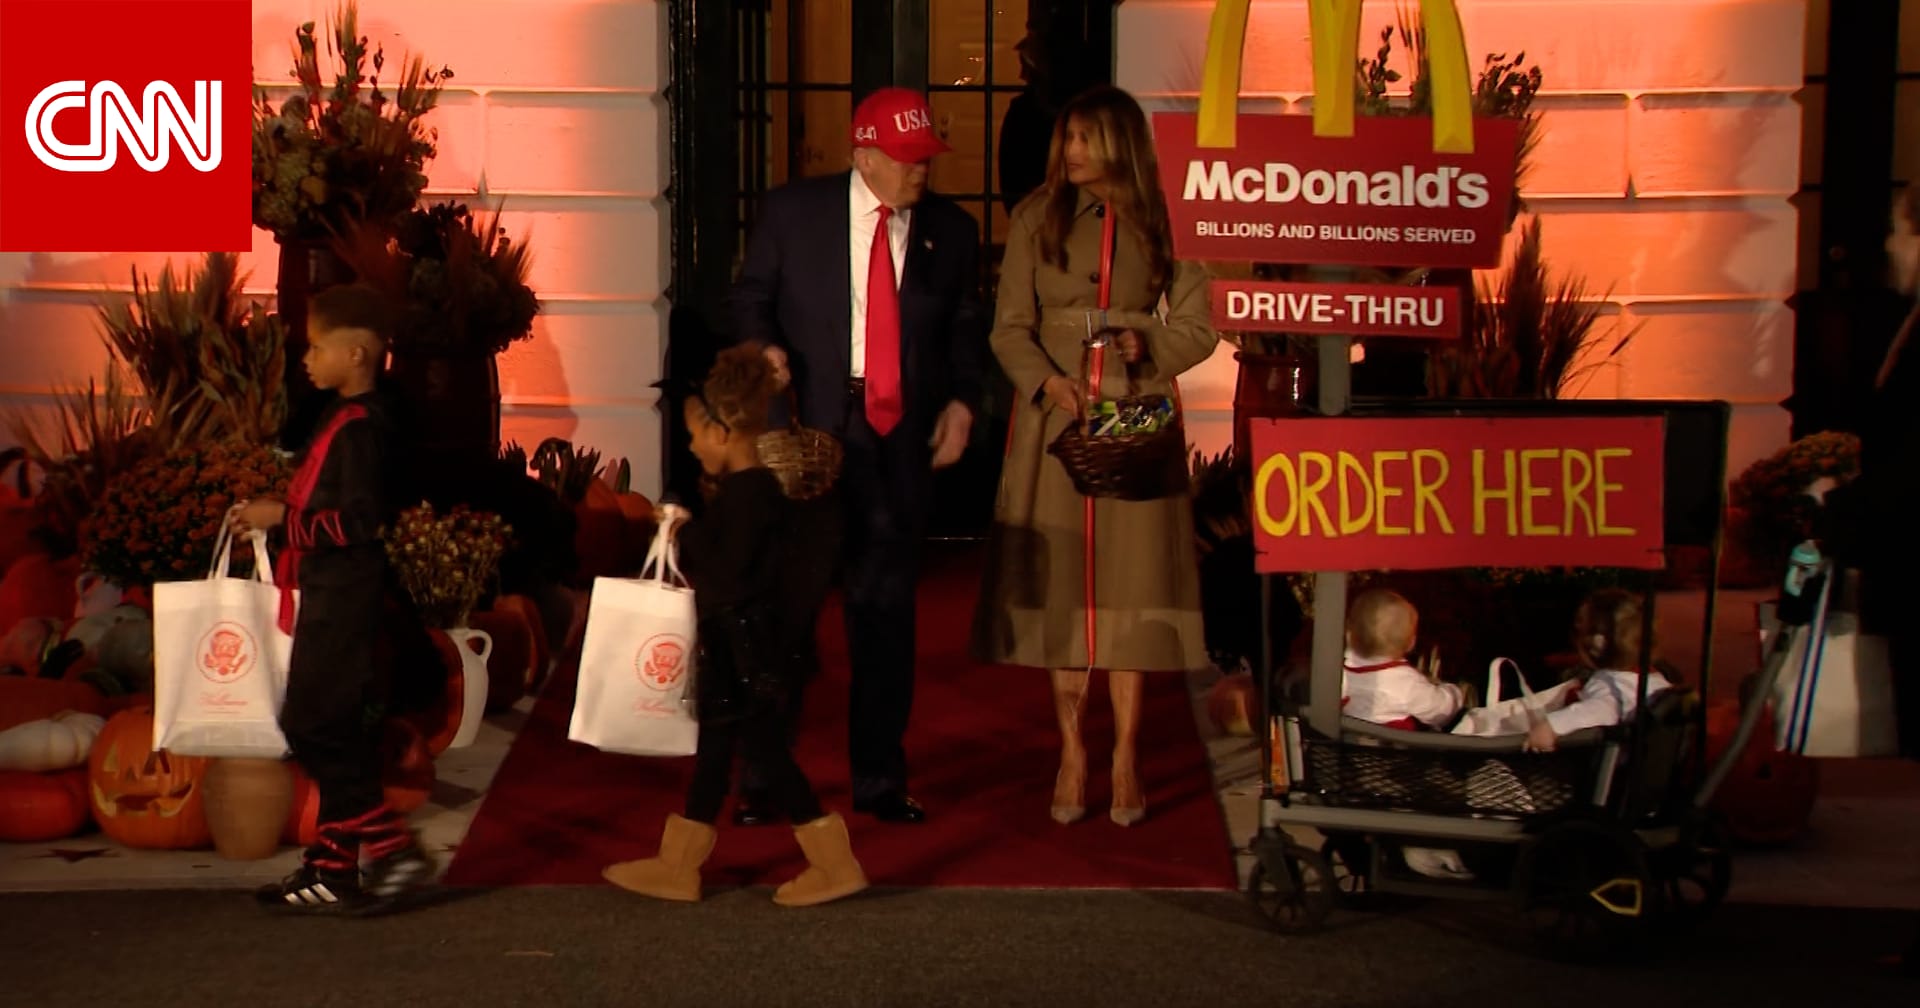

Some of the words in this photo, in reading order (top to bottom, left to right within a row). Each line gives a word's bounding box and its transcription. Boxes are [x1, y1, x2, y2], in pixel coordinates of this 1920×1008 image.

[893, 109, 931, 133] USA
[1183, 161, 1489, 208] McDonald's
[1196, 221, 1275, 238] BILLIONS
[1278, 224, 1316, 239] AND
[1319, 225, 1400, 242] BILLIONS
[1404, 227, 1476, 243] SERVED
[1227, 291, 1443, 327] DRIVE-THRU
[1254, 449, 1454, 537] ORDER
[1472, 448, 1637, 537] HERE
